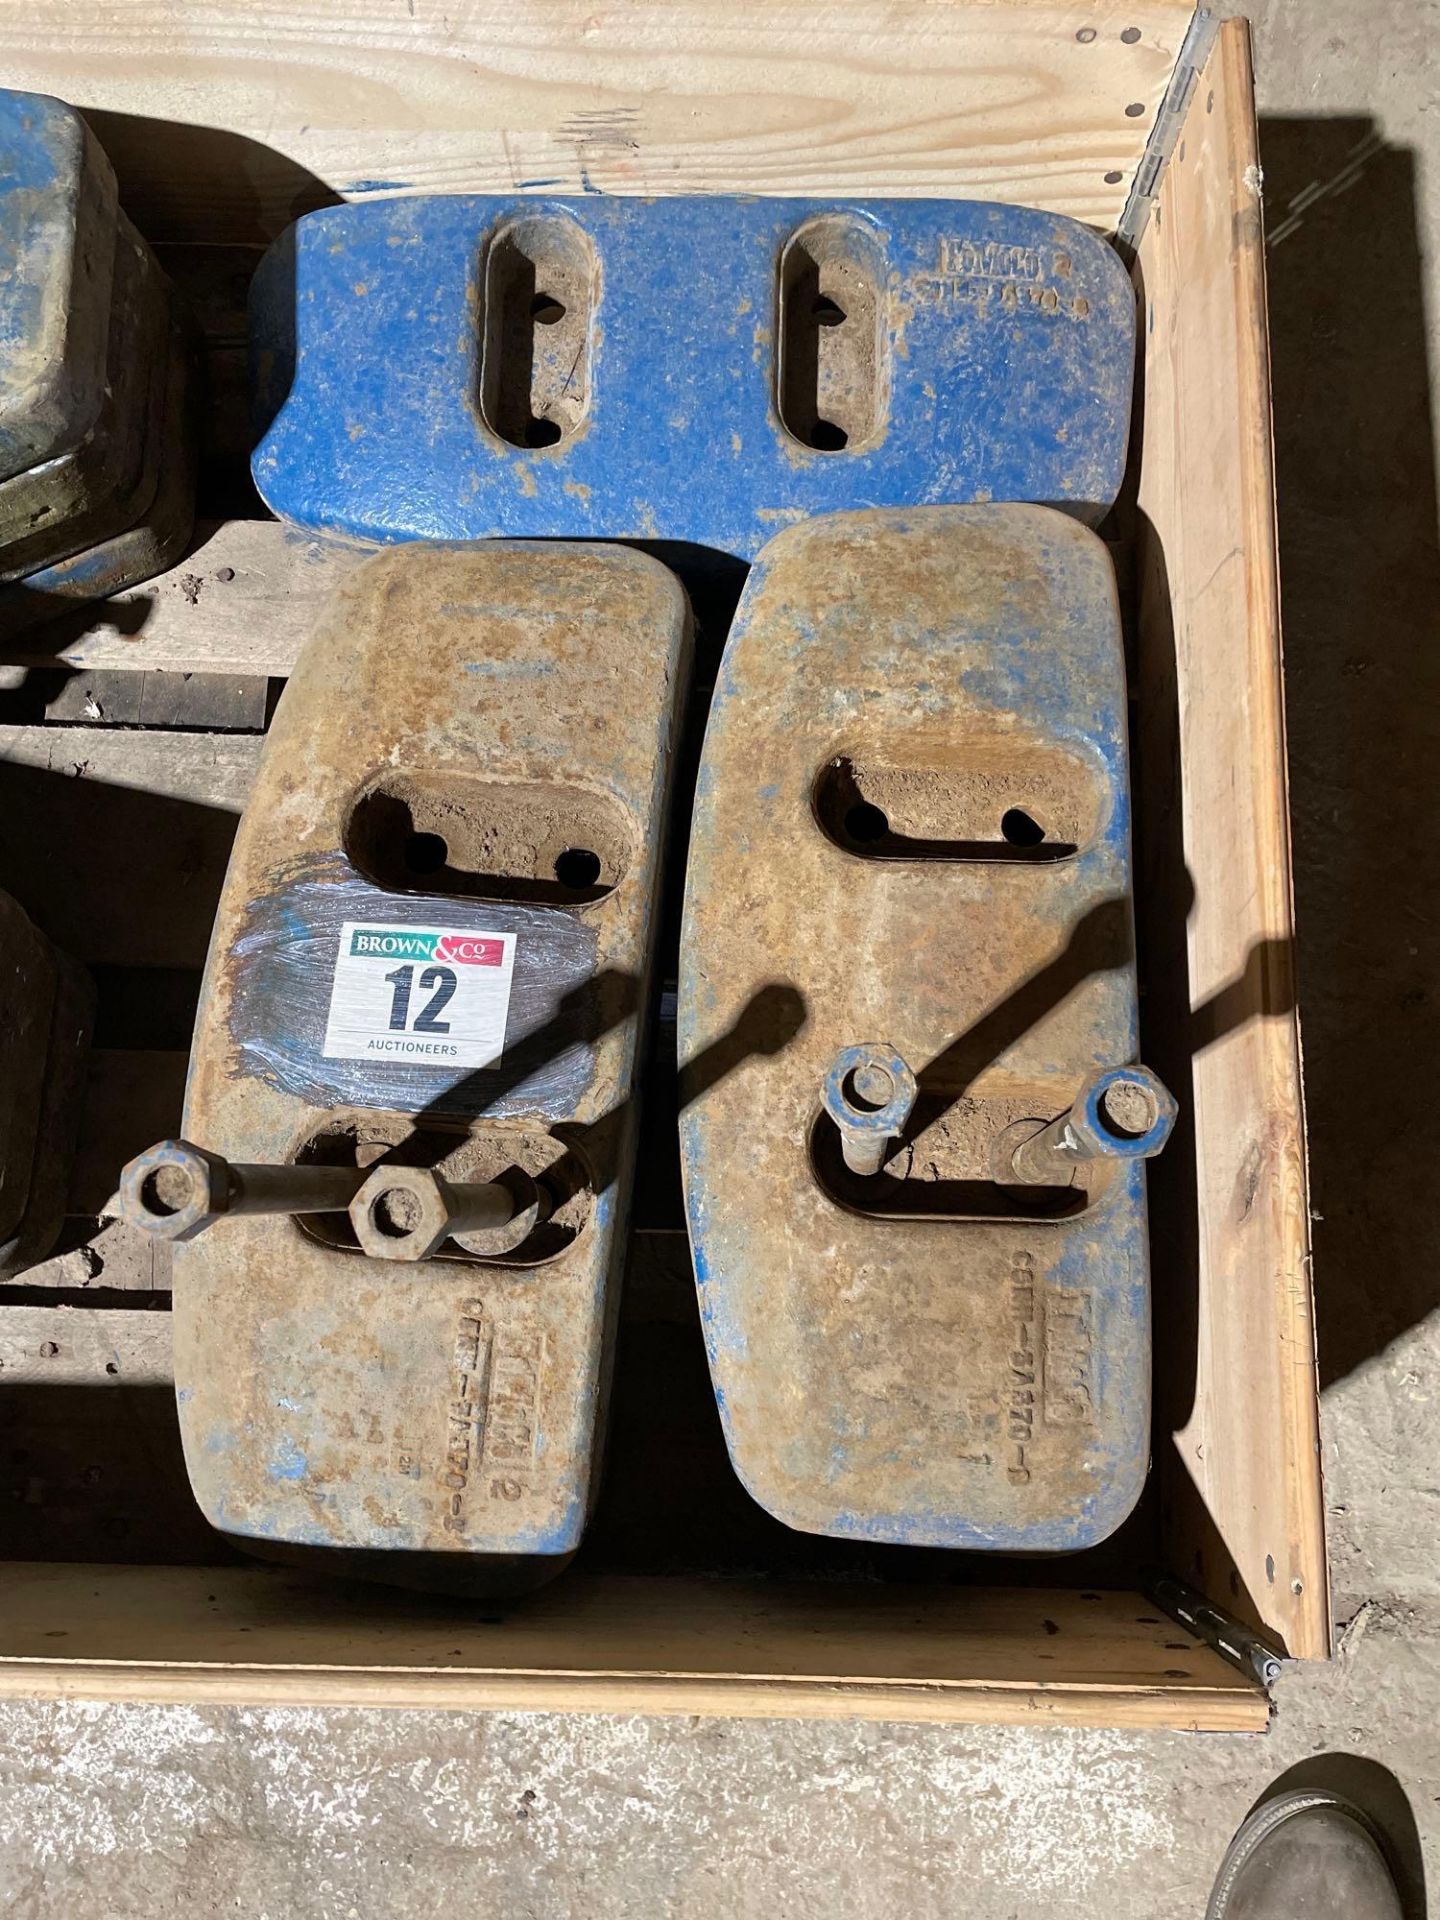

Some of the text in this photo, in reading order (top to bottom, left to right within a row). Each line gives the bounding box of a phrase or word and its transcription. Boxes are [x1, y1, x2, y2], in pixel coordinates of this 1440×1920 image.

[384, 964, 458, 1034] 12
[367, 1039, 458, 1056] AUCTIONEERS
[490, 1477, 522, 1502] 2
